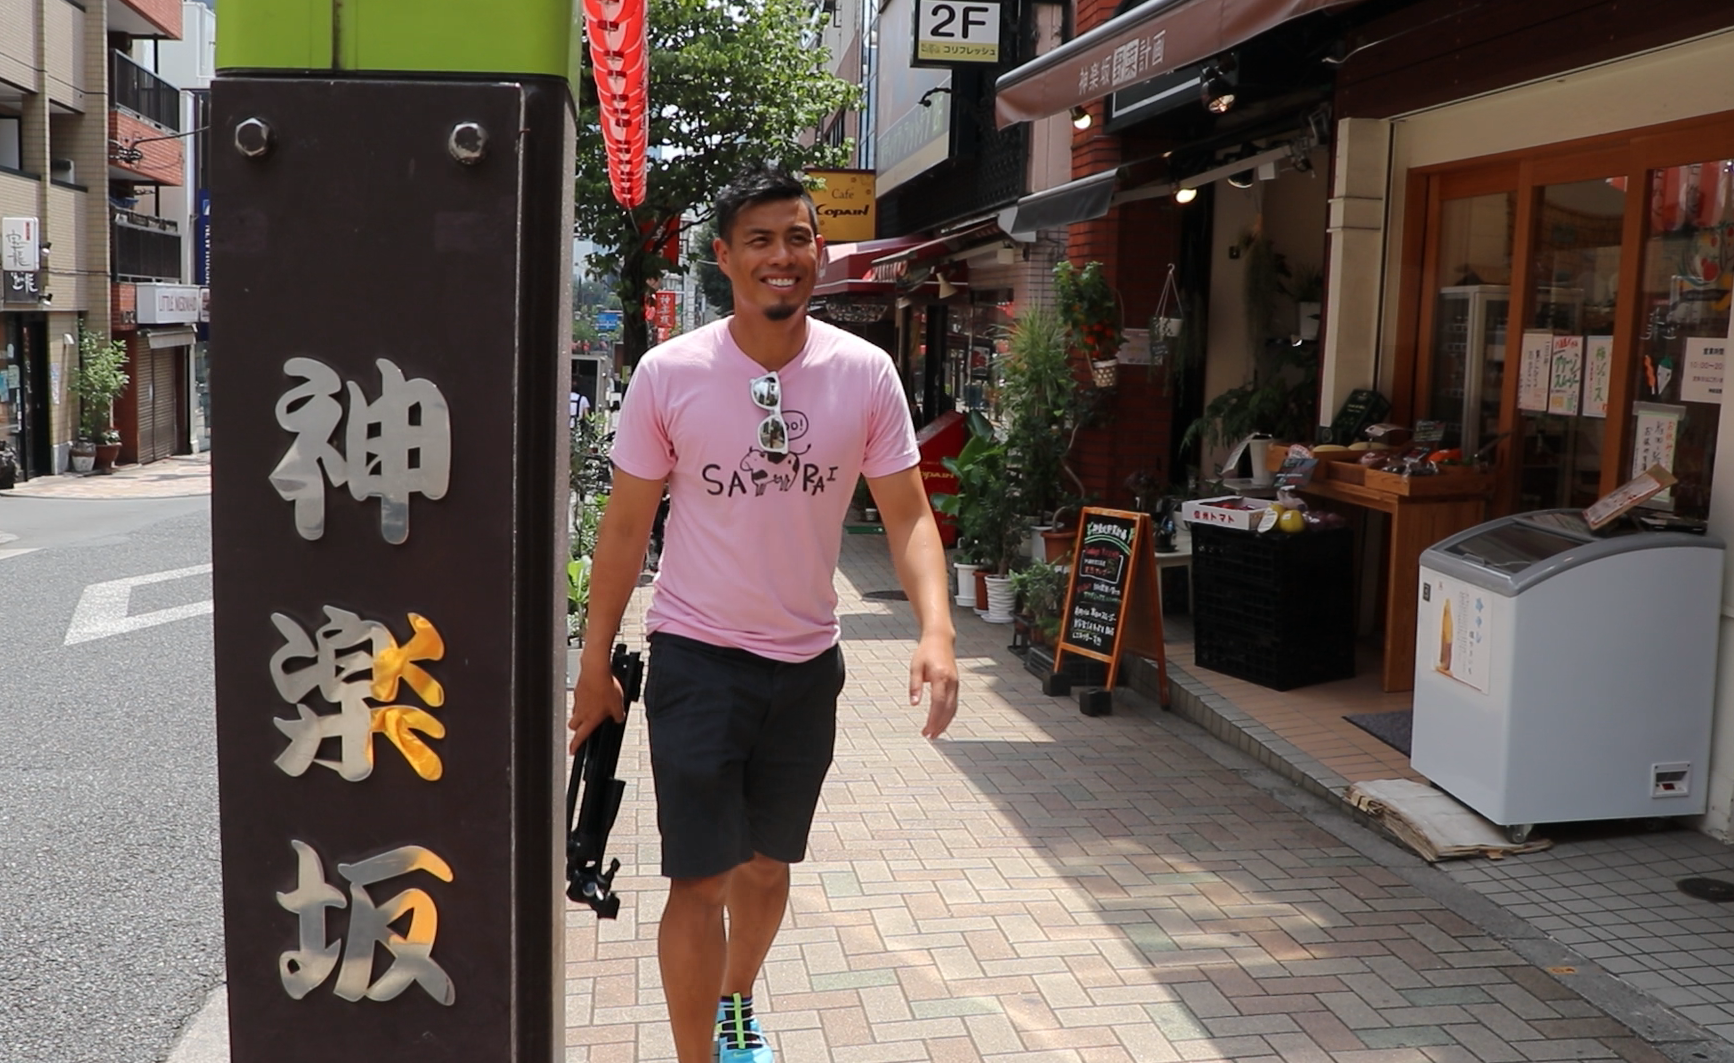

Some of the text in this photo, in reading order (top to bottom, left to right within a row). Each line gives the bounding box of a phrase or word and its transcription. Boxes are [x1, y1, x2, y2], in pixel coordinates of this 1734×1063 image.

[930, 3, 989, 39] 2F
[269, 357, 456, 1006] 神楽坂
